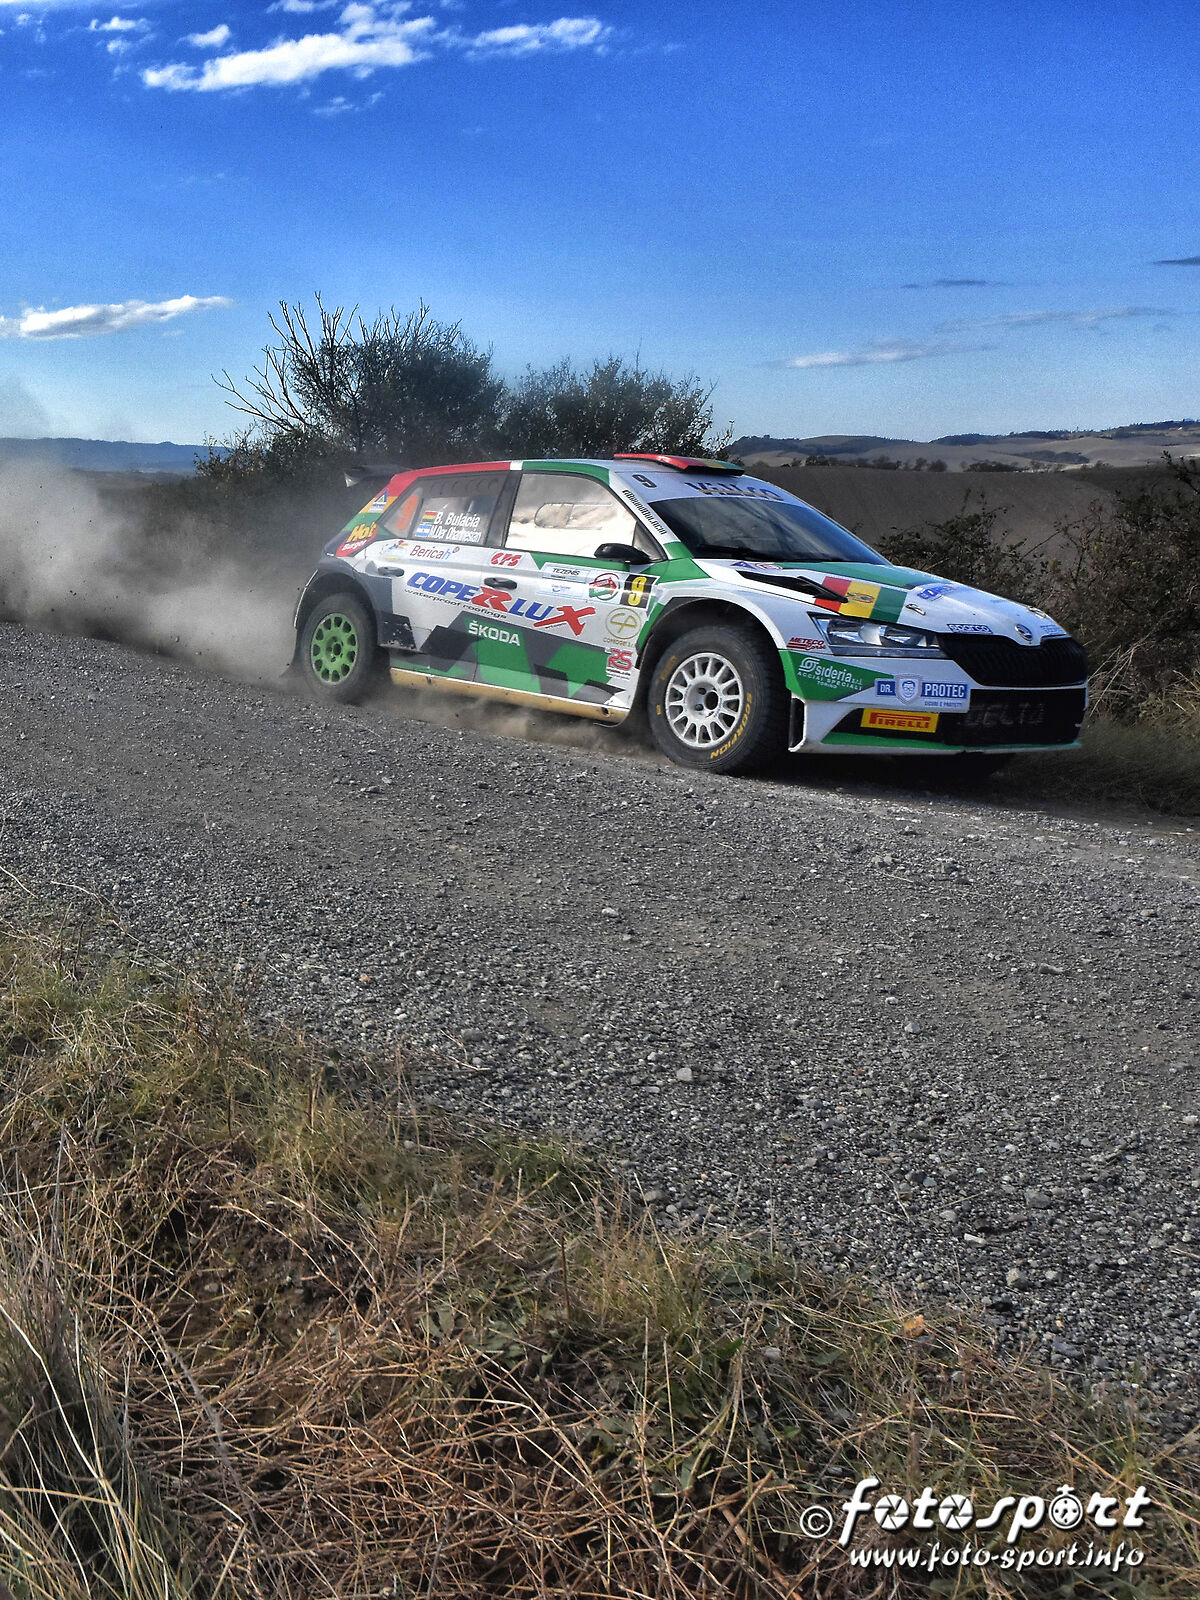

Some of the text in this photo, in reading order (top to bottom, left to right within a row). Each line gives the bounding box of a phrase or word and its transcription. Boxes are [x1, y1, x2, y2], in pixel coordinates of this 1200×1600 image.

[434, 511, 480, 528] B. Bulacia
[410, 545, 452, 561] Bericah
[552, 567, 580, 576] TEZENIS
[628, 576, 647, 606] 9
[404, 588, 508, 620] waterproof roofings
[407, 572, 596, 636] COPERLUX
[468, 620, 520, 646] ŠKODA
[789, 637, 824, 646] METECO
[797, 671, 862, 690] ACCIAI SPECIALI
[815, 666, 852, 683] sideria
[817, 680, 838, 689] TORINO
[880, 683, 965, 698] DR. PROTEC
[710, 692, 753, 759] SCORPION
[869, 712, 931, 728] PIRELLI
